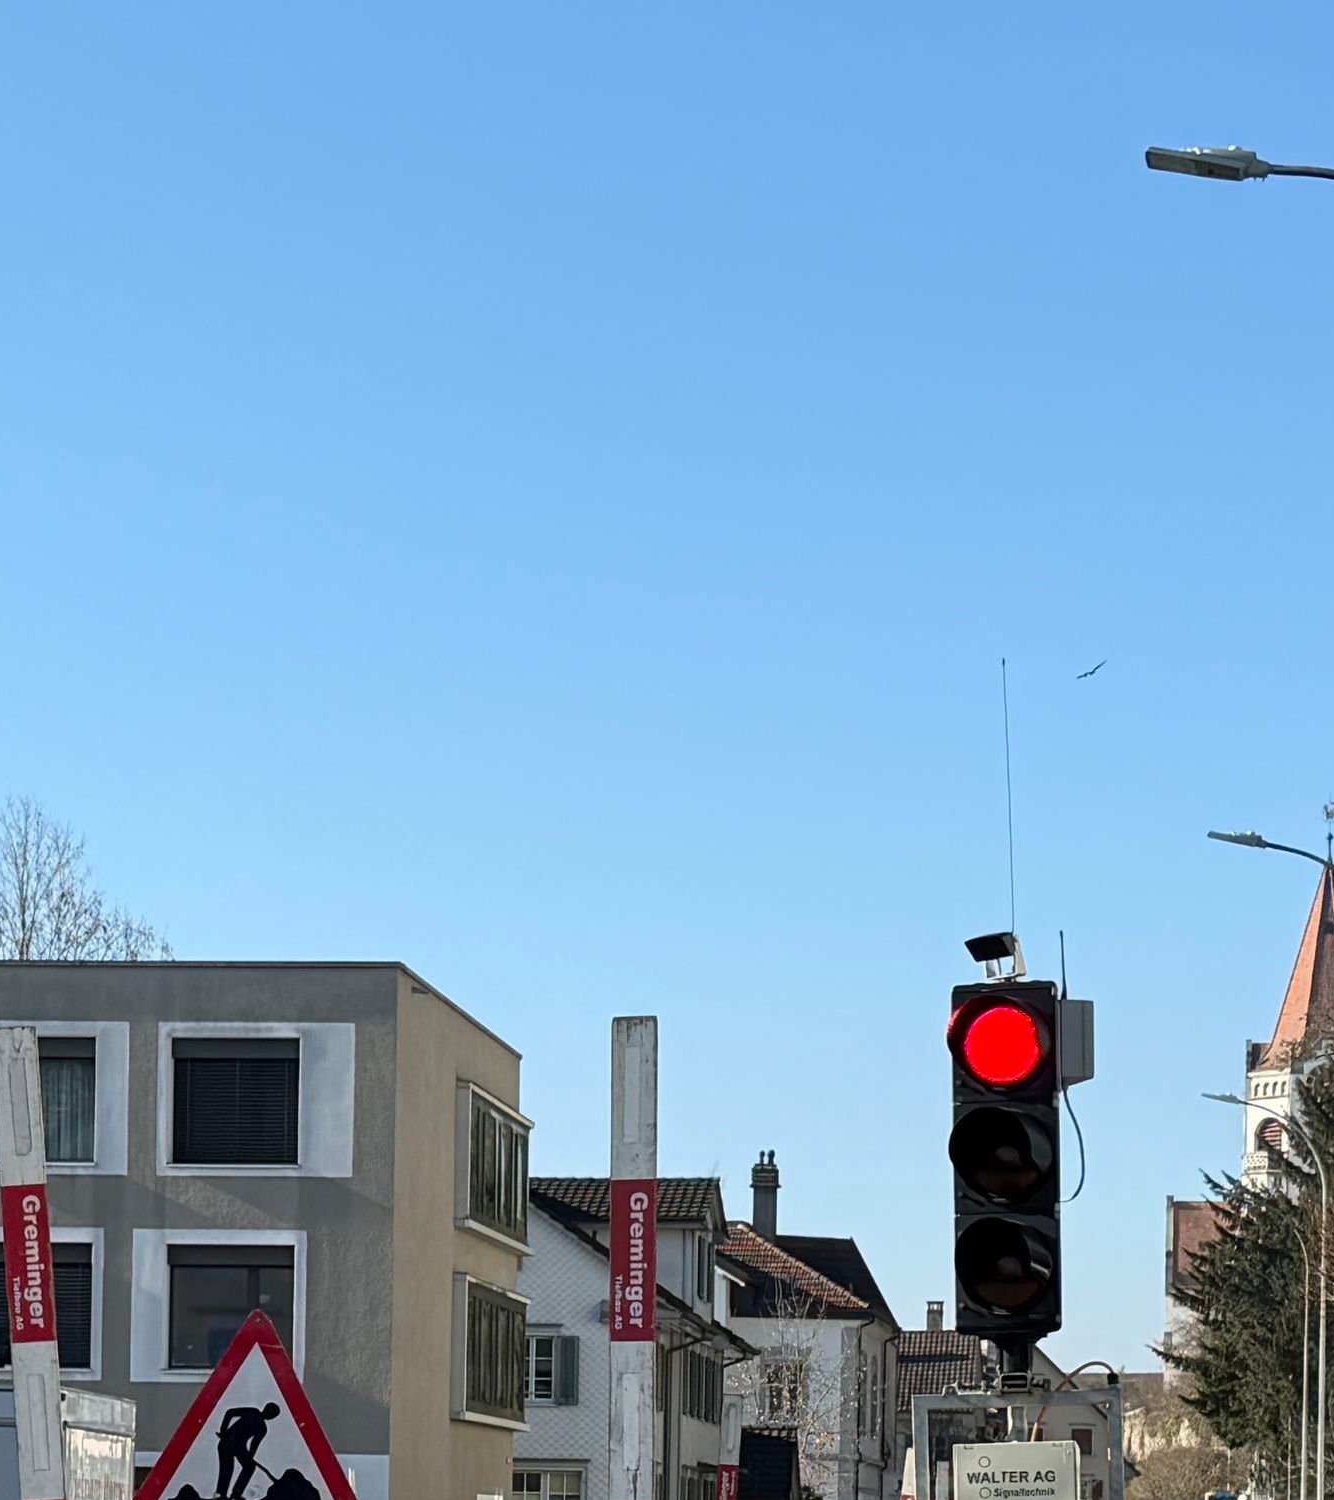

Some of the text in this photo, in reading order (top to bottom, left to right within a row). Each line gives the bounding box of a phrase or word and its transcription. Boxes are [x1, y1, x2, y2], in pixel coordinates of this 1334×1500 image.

[22, 1194, 45, 1329] Greminger
[625, 1192, 648, 1328] Greminger
[967, 1470, 1055, 1484] WALTER AG
[993, 1488, 1055, 1499] Signaltechnik
